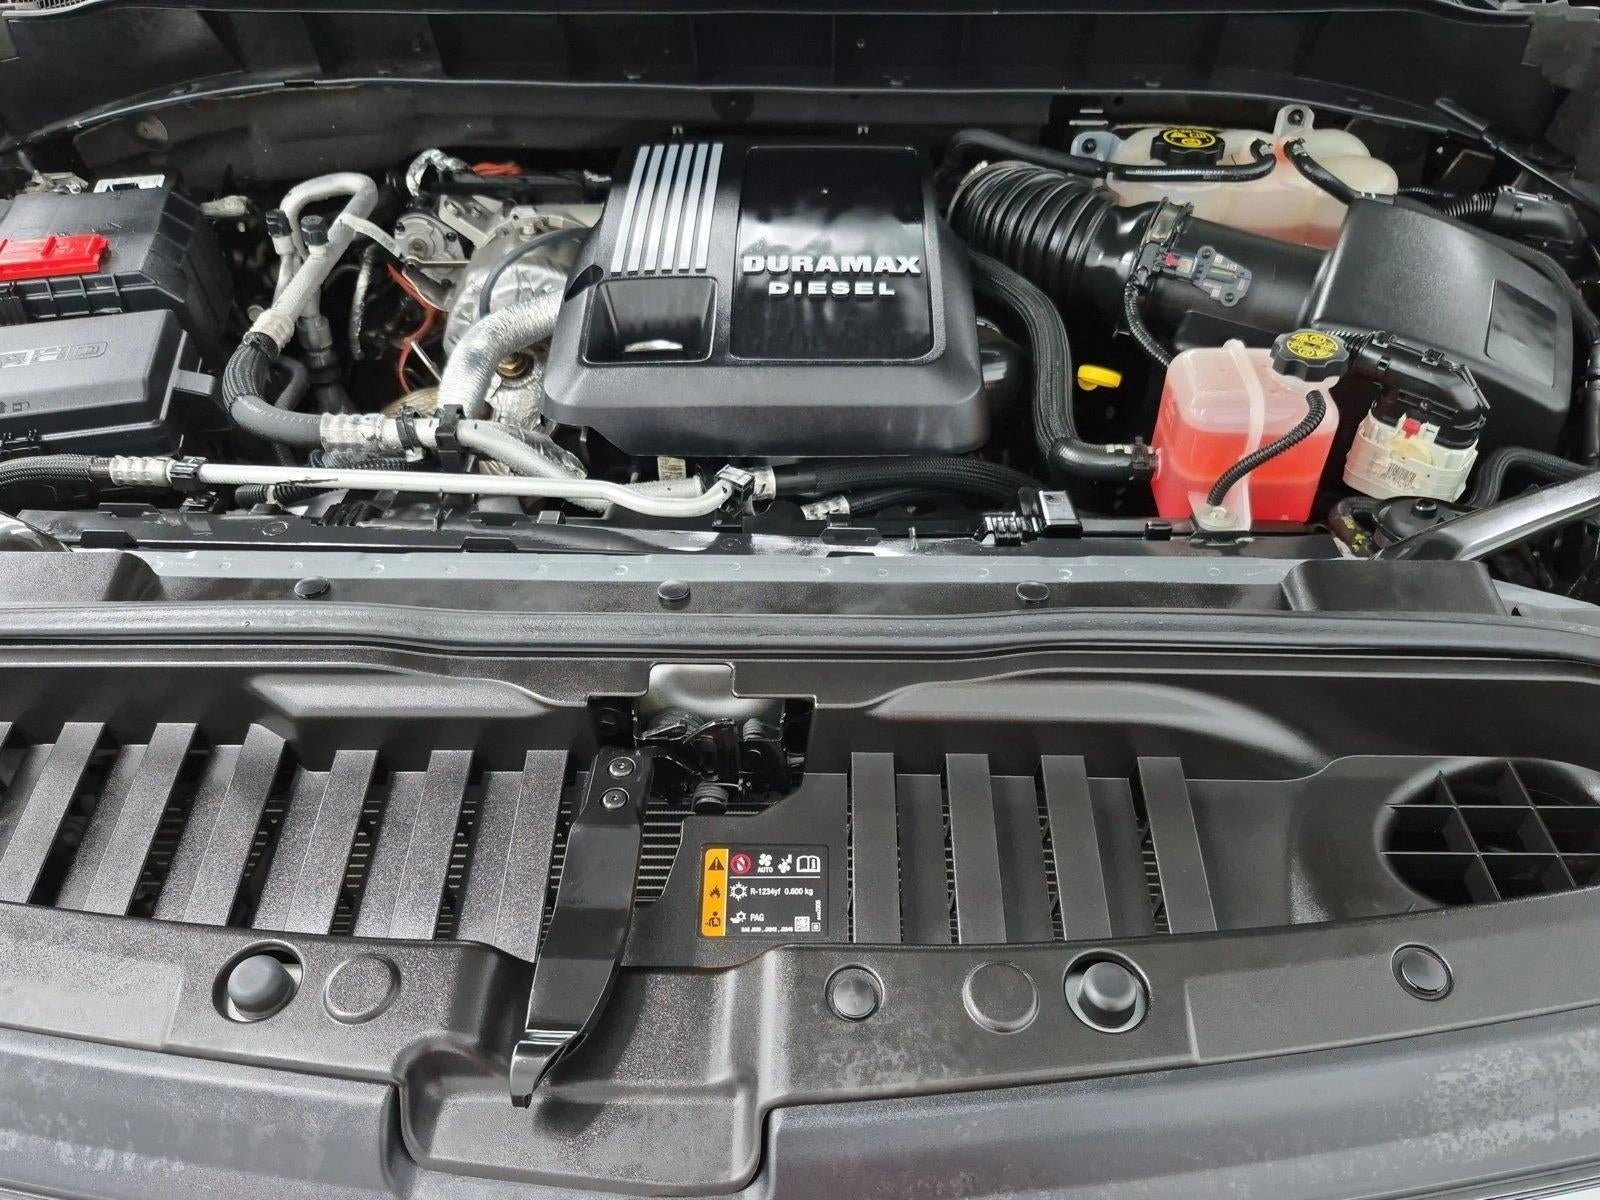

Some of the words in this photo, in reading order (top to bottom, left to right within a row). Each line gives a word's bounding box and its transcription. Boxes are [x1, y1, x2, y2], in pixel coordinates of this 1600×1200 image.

[743, 256, 921, 274] DURAMAX
[768, 281, 895, 296] DIESEL
[750, 888, 781, 896] R-1234yf
[804, 888, 813, 896] kg
